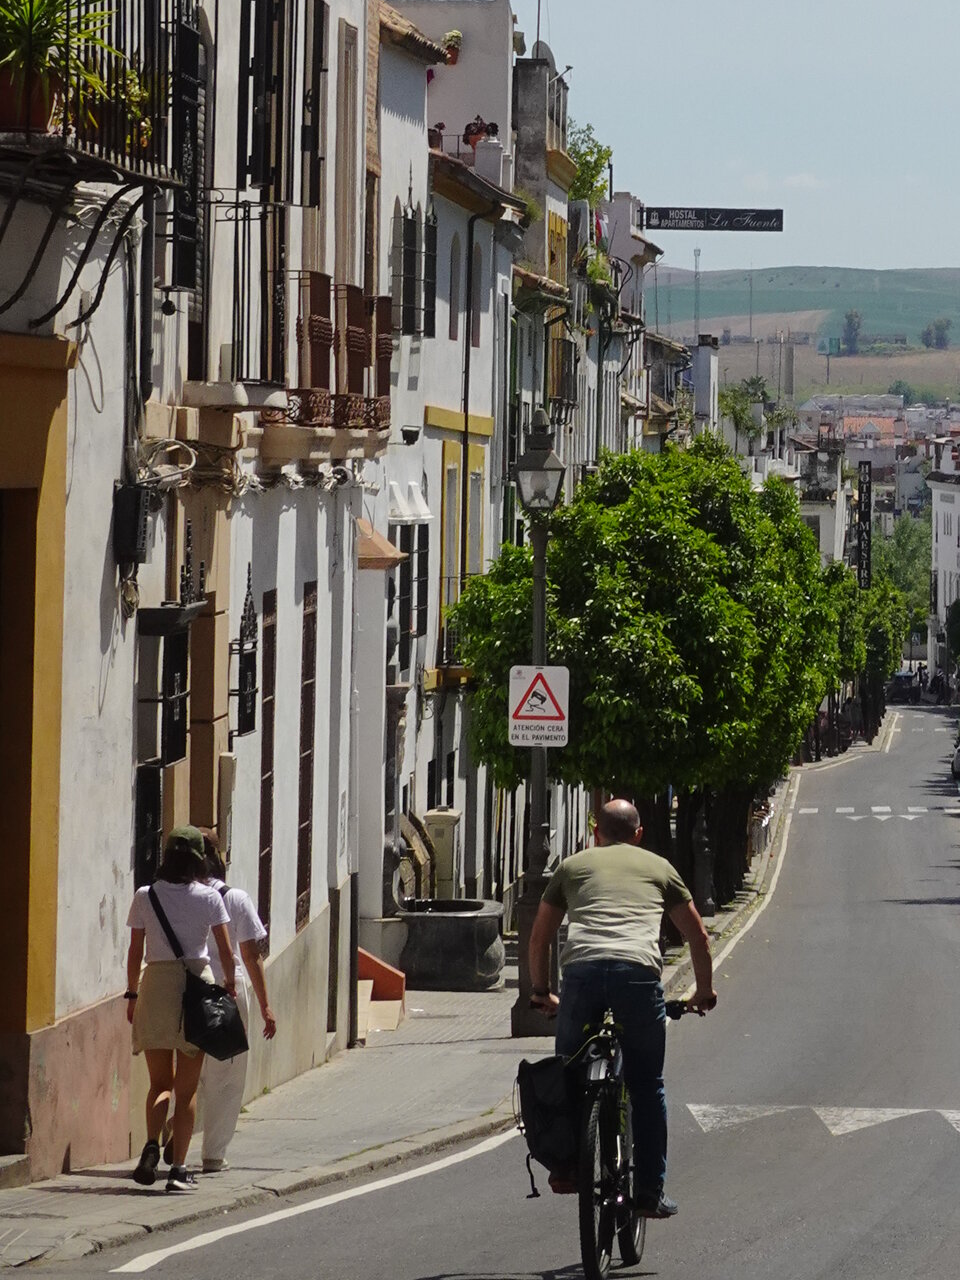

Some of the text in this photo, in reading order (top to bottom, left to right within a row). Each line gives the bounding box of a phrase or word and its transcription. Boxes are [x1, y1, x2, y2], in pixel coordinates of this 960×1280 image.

[669, 210, 697, 219] HOSTAL
[710, 212, 780, 228] La Fuente
[661, 219, 704, 228] APARTAMENTOS
[860, 464, 869, 588] HOTEL MAESTRE
